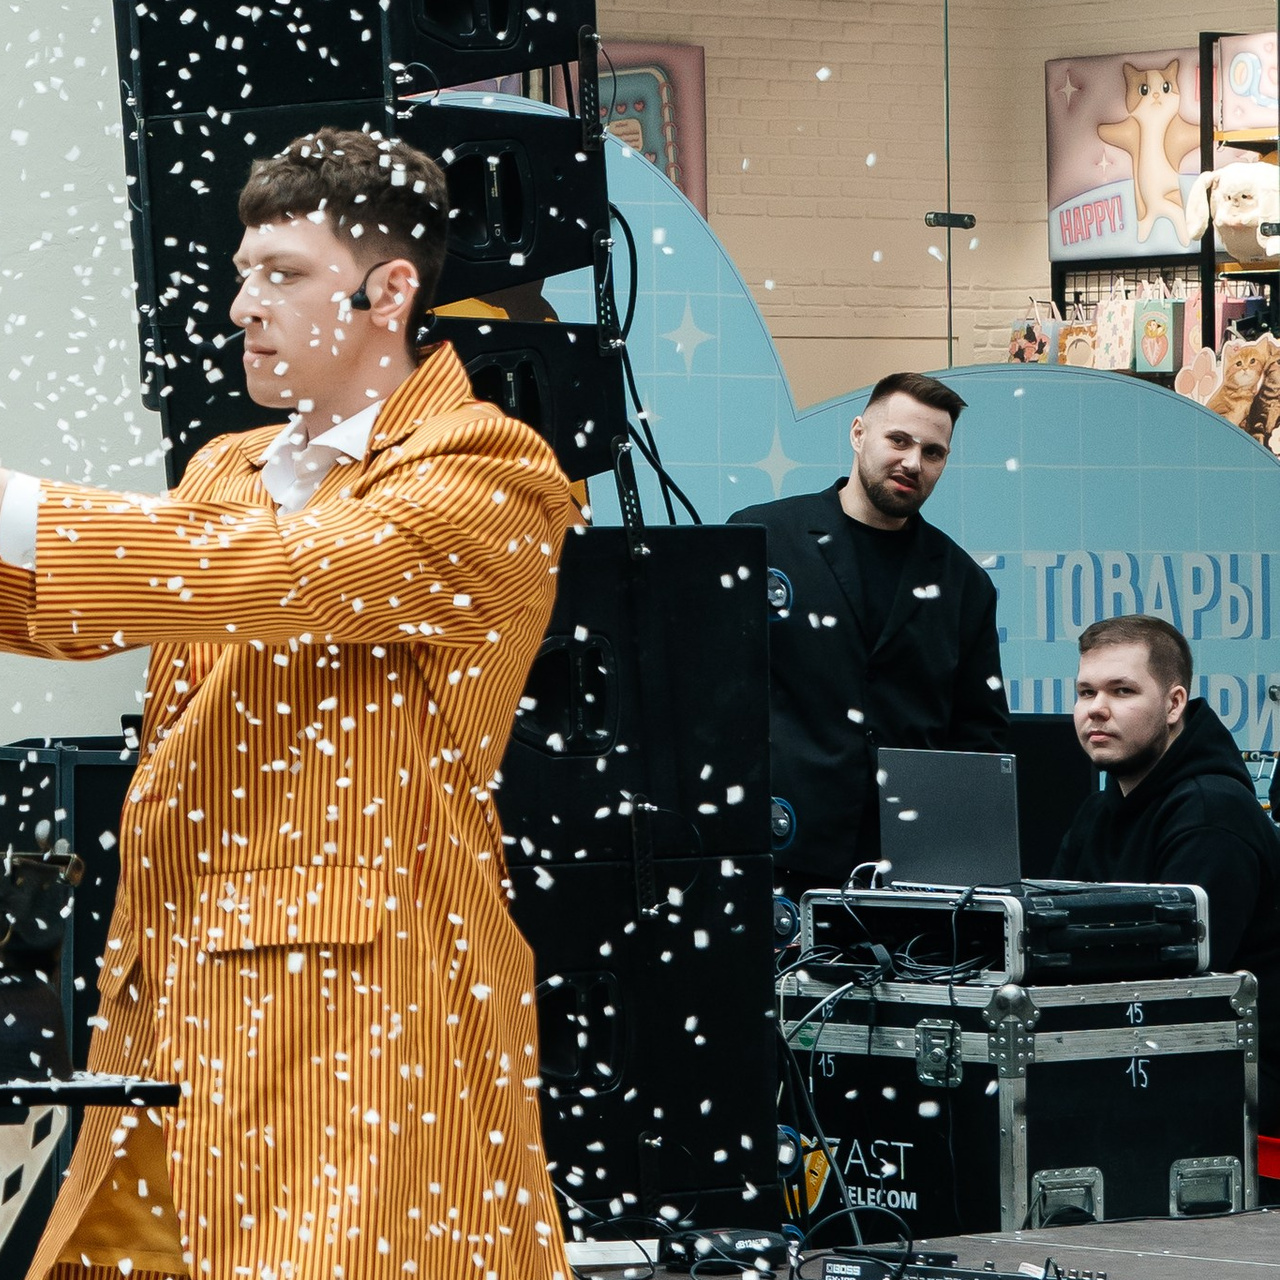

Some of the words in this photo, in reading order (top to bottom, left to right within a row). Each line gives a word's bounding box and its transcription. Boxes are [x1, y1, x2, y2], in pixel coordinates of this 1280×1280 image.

[1059, 195, 1125, 247] HAPPY!
[1024, 550, 1270, 642] ТОВАРЫ
[1126, 1003, 1143, 1024] 15
[818, 1053, 835, 1077] 15
[1126, 1058, 1150, 1088] 15
[833, 1263, 861, 1276] BOSS
